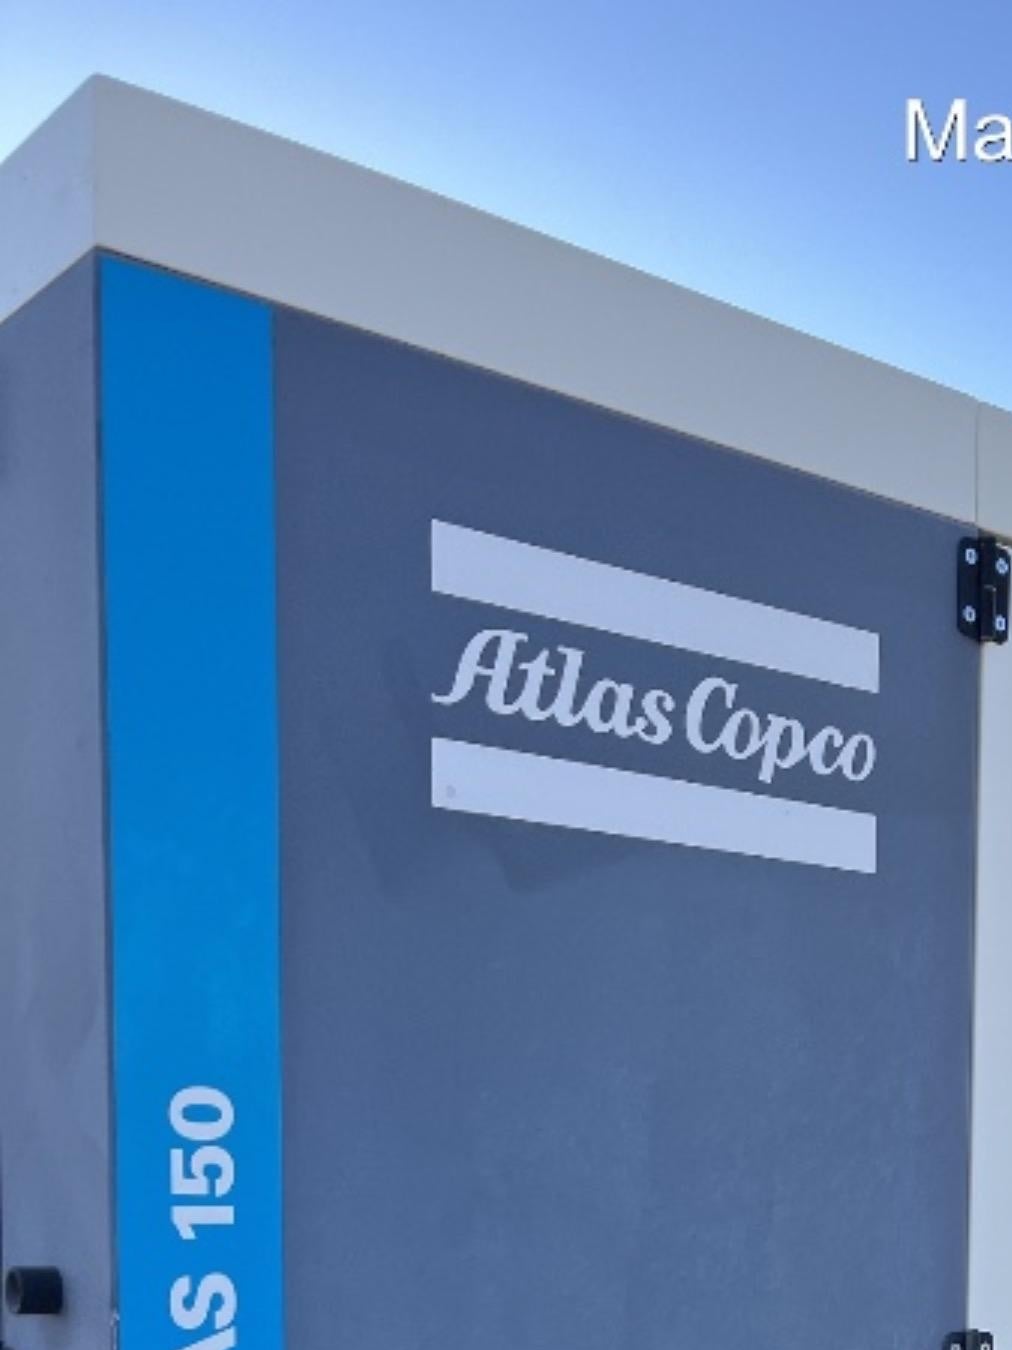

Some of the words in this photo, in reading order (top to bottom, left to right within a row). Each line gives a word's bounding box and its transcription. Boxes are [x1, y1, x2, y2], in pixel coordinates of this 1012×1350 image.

[431, 628, 675, 746] Atlas
[686, 676, 877, 784] Copco
[168, 1085, 236, 1241] 150
